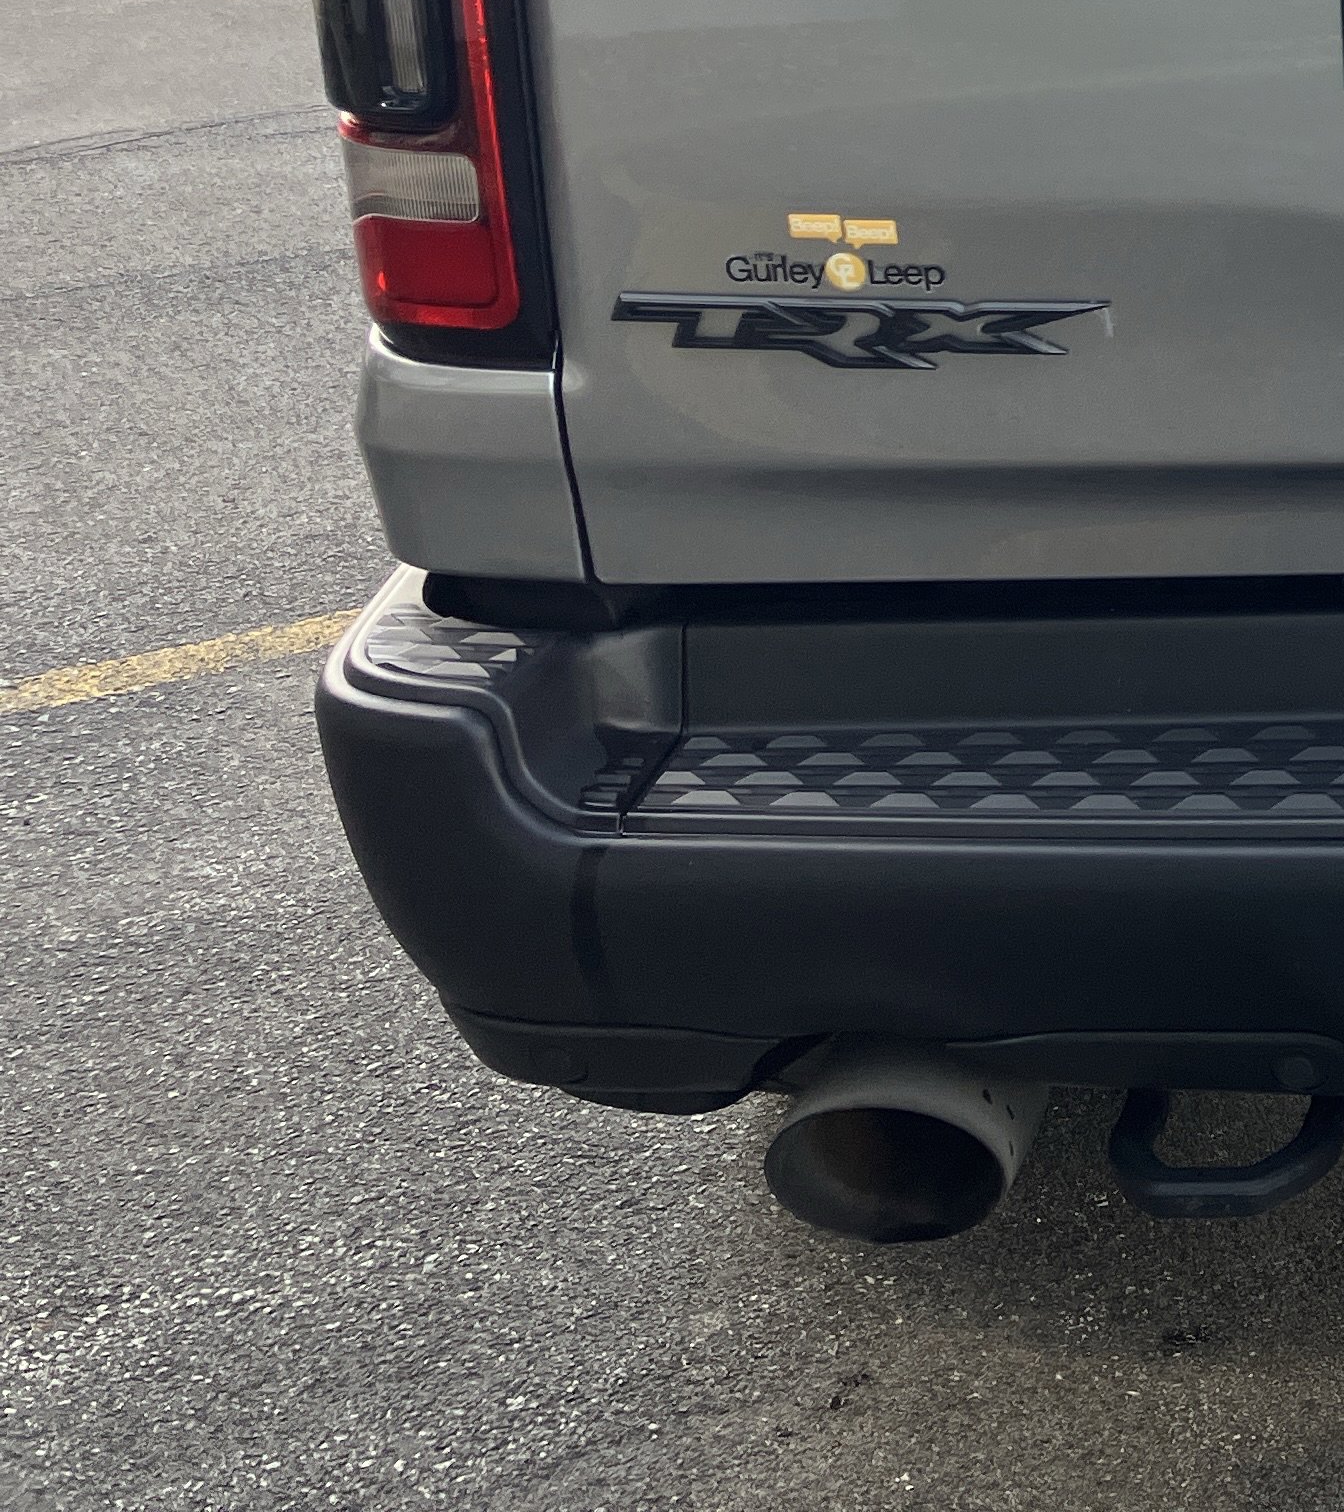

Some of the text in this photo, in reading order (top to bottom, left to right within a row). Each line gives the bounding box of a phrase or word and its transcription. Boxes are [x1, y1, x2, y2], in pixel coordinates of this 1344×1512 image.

[725, 254, 826, 289] Gurley
[867, 259, 945, 291] Leep
[611, 292, 1111, 370] TRX
